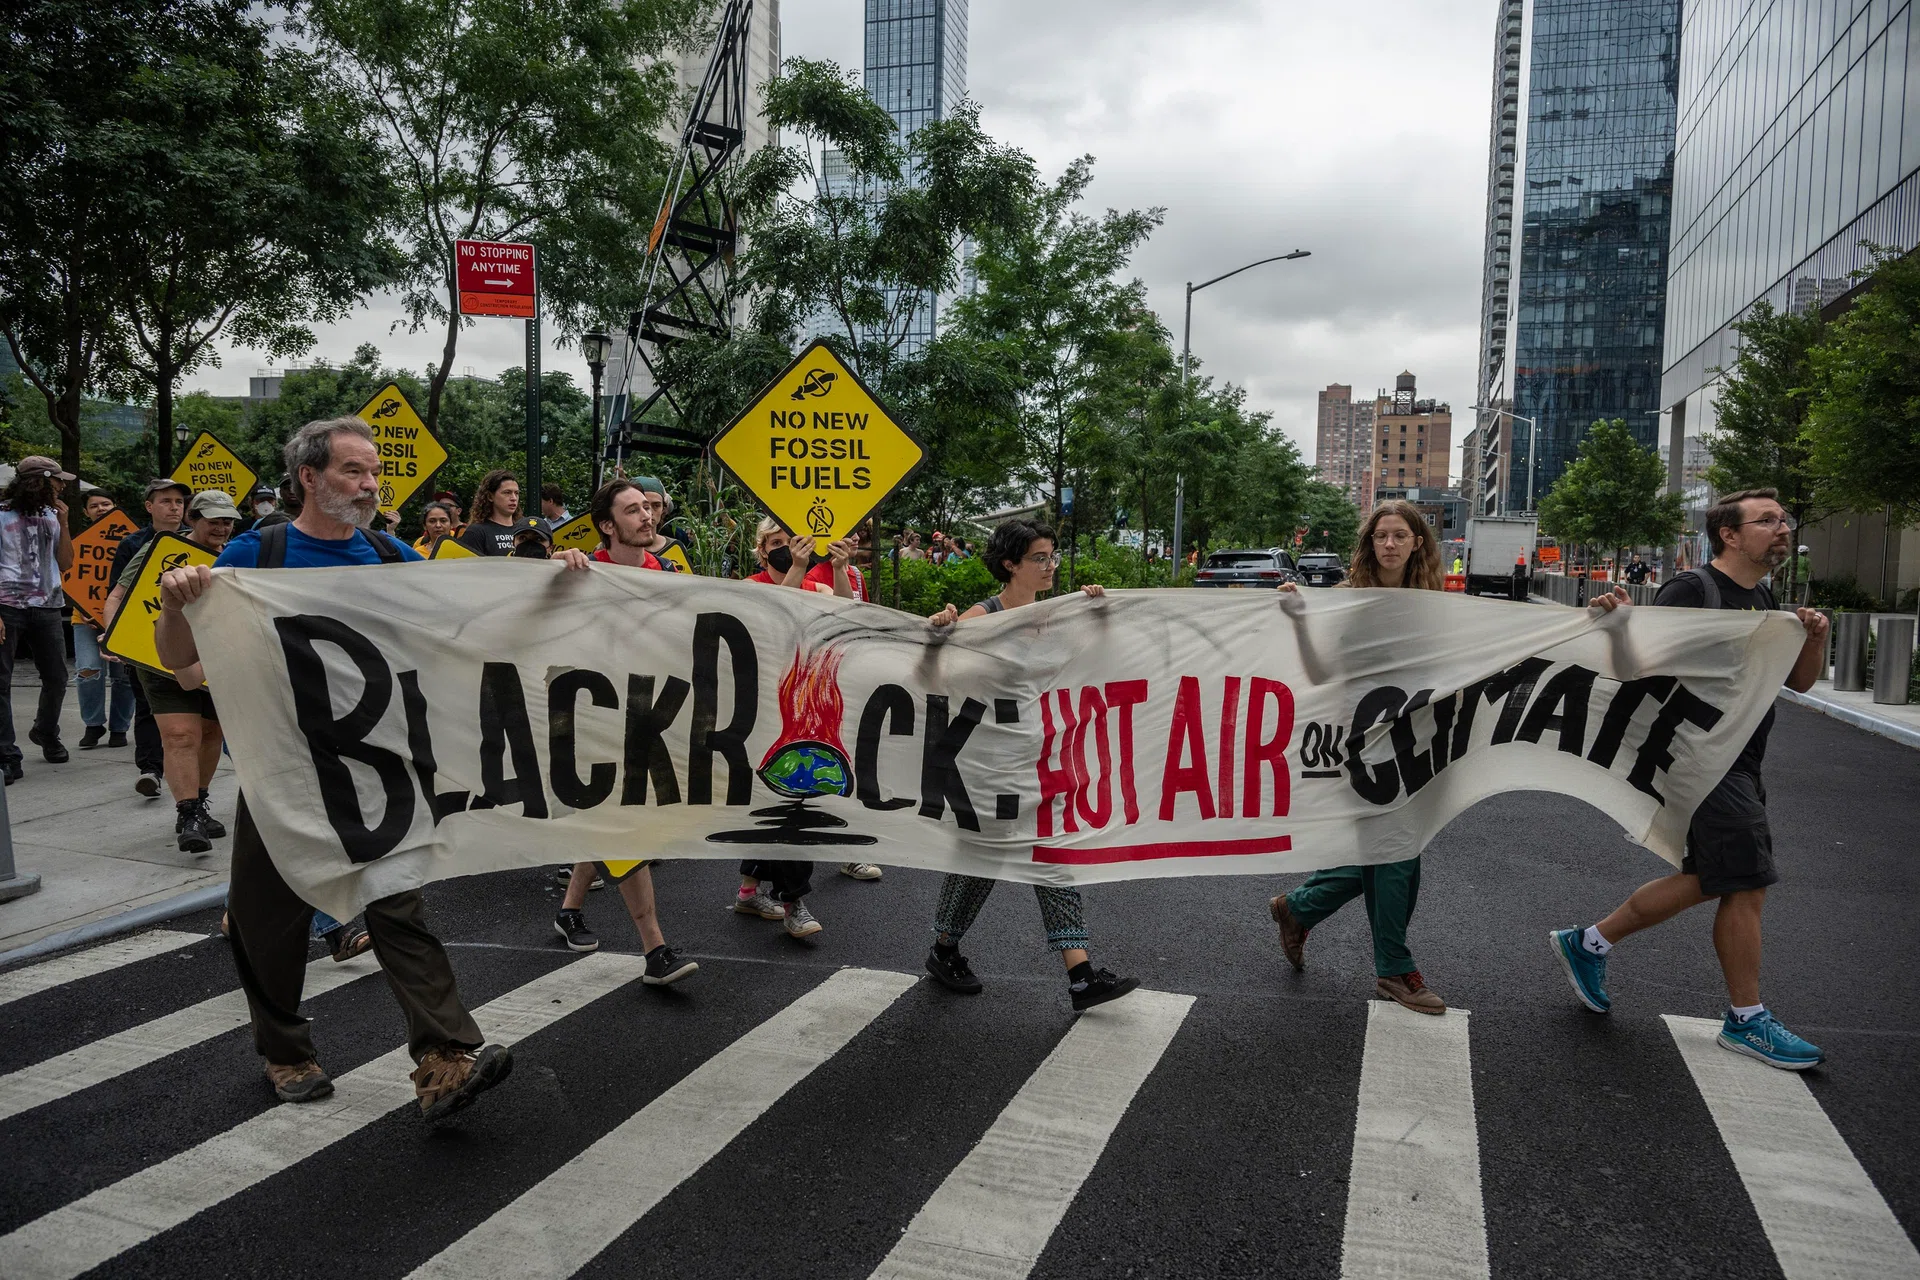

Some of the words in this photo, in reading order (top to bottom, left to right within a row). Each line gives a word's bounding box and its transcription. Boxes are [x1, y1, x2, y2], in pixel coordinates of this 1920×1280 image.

[461, 245, 476, 257] NO
[480, 246, 529, 260] STOPPING
[471, 261, 521, 274] ANYTIME
[770, 410, 806, 429] NO
[813, 412, 869, 430] NEW
[384, 426, 419, 440] NEW
[374, 442, 418, 459] SSIL
[770, 437, 871, 460] FOSSIL
[189, 462, 206, 472] NO
[208, 461, 233, 471] NEW
[380, 460, 418, 478] ELS
[191, 473, 236, 486] FOSSIL
[771, 466, 872, 490] FUELS
[1036, 678, 1148, 838] HOT
[1158, 675, 1295, 822] AIR
[1300, 721, 1344, 769] ON
[1343, 656, 1725, 808] CLIMATE
